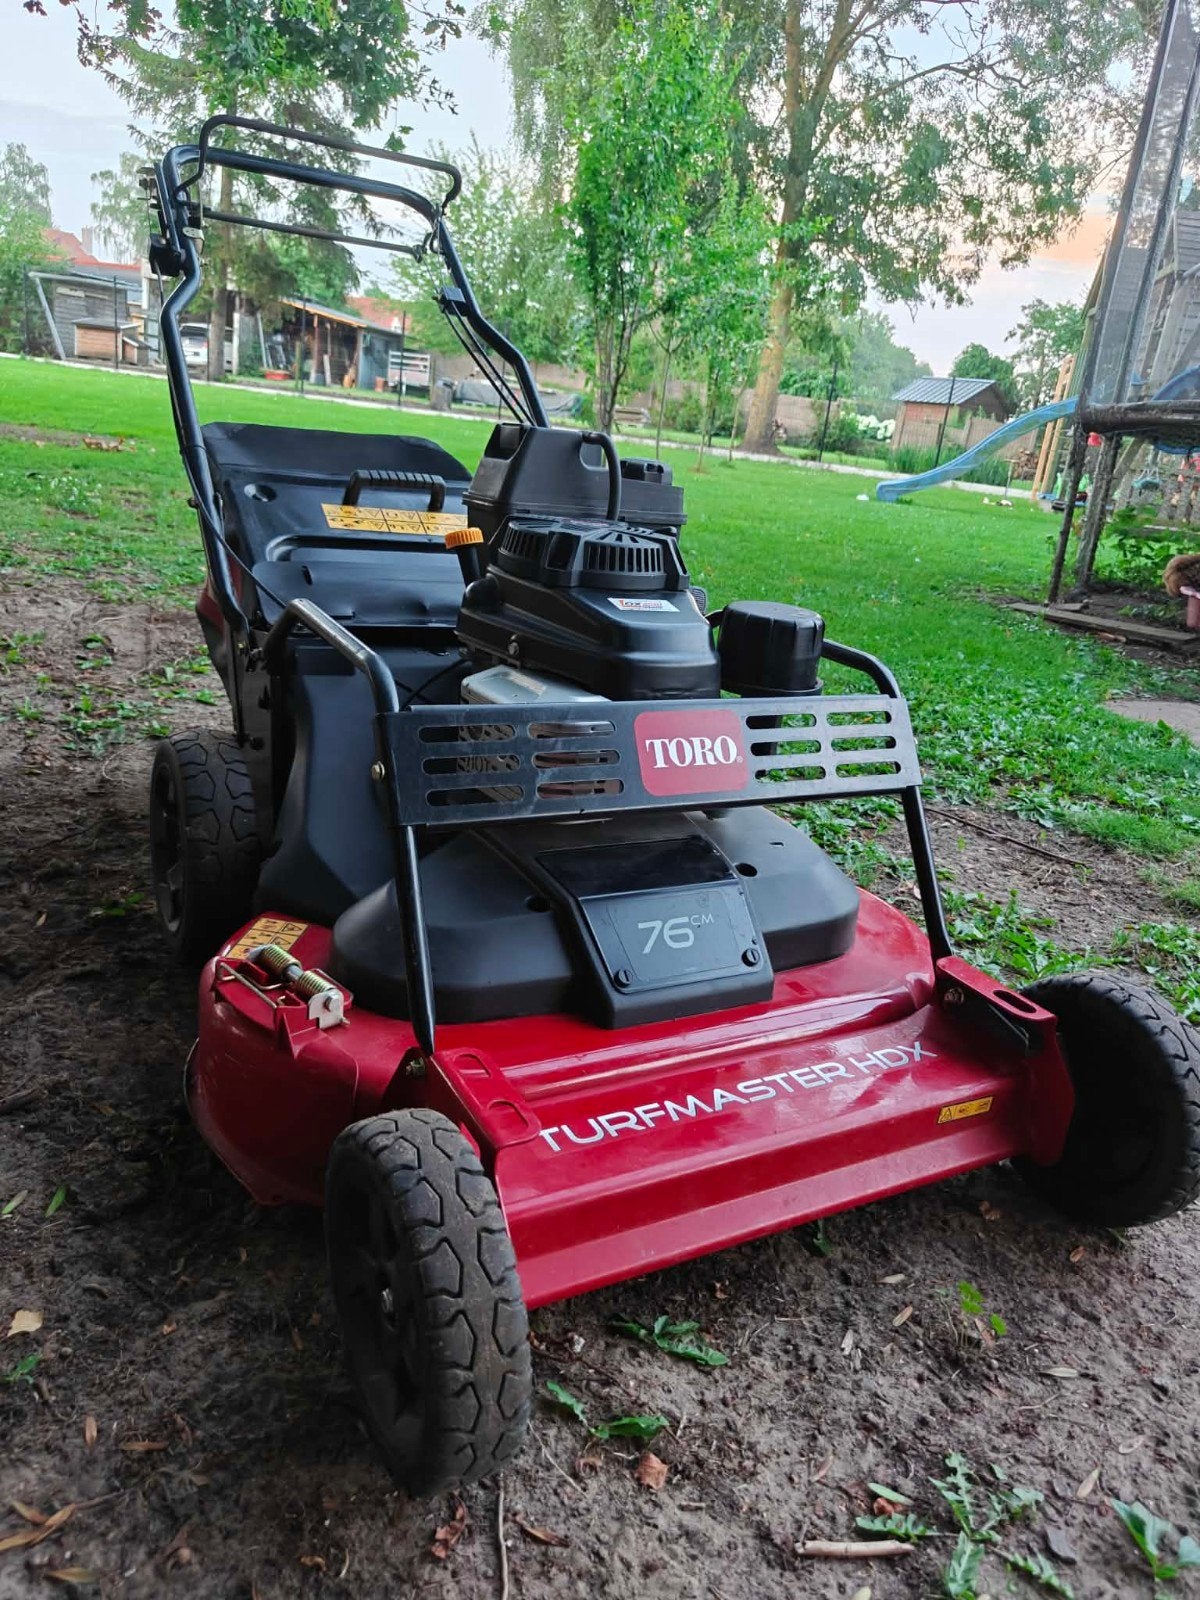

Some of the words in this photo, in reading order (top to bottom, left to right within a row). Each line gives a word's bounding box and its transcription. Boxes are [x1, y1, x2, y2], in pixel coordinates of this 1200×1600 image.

[645, 735, 738, 769] TORO
[538, 1061, 855, 1152] TURFMASTER
[848, 1041, 938, 1075] HDX
